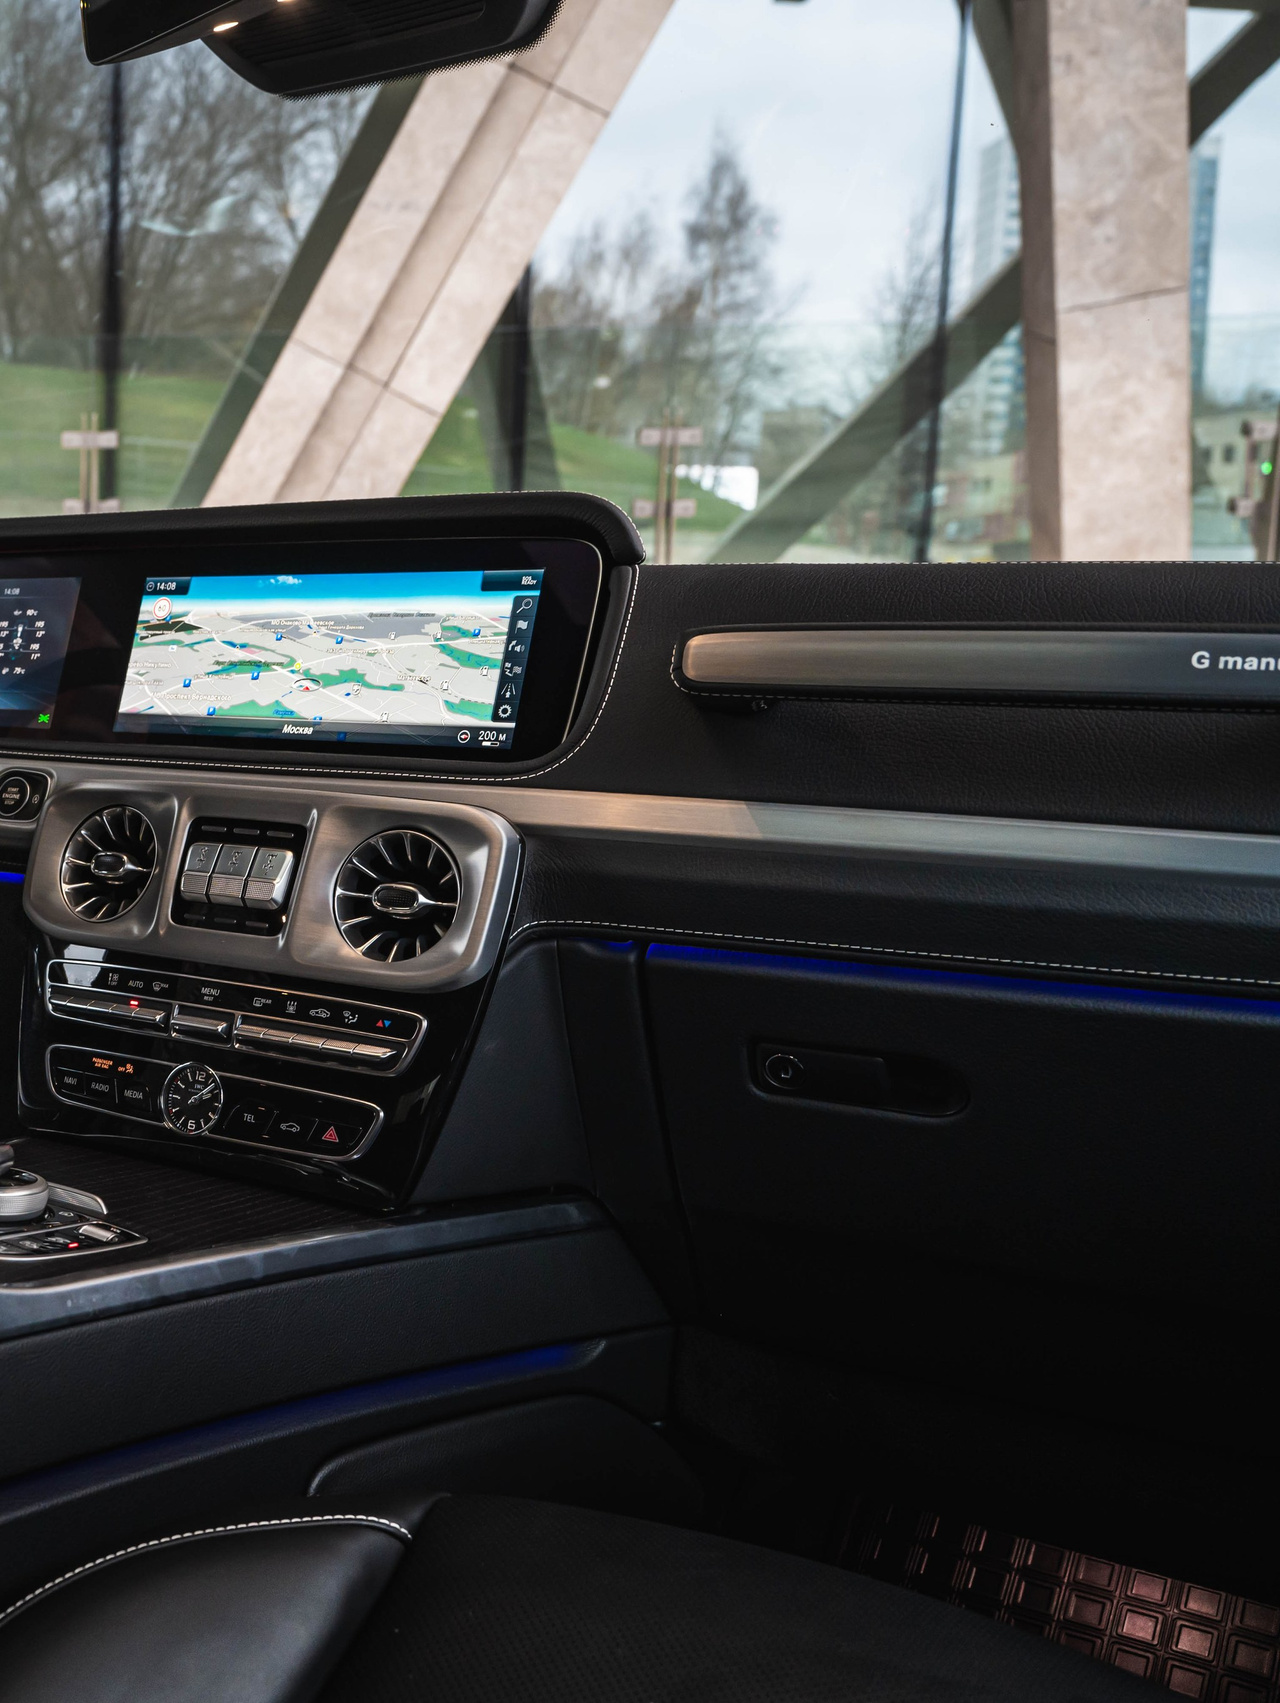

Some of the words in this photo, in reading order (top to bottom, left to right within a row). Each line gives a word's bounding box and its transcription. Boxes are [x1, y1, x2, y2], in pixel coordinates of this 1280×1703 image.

[156, 582, 176, 590] 14:08
[1191, 650, 1210, 669] G
[1218, 656, 1280, 671] man
[282, 724, 313, 735] Москва
[478, 731, 497, 740] 200
[128, 980, 144, 988] AUTO
[201, 987, 220, 996] MENU
[63, 1076, 77, 1085] NAVI
[195, 1070, 206, 1081] 12
[91, 1082, 109, 1092] RADIO
[123, 1089, 143, 1099] MEDIA
[243, 1113, 255, 1123] TEL
[187, 1120, 195, 1130] 6
